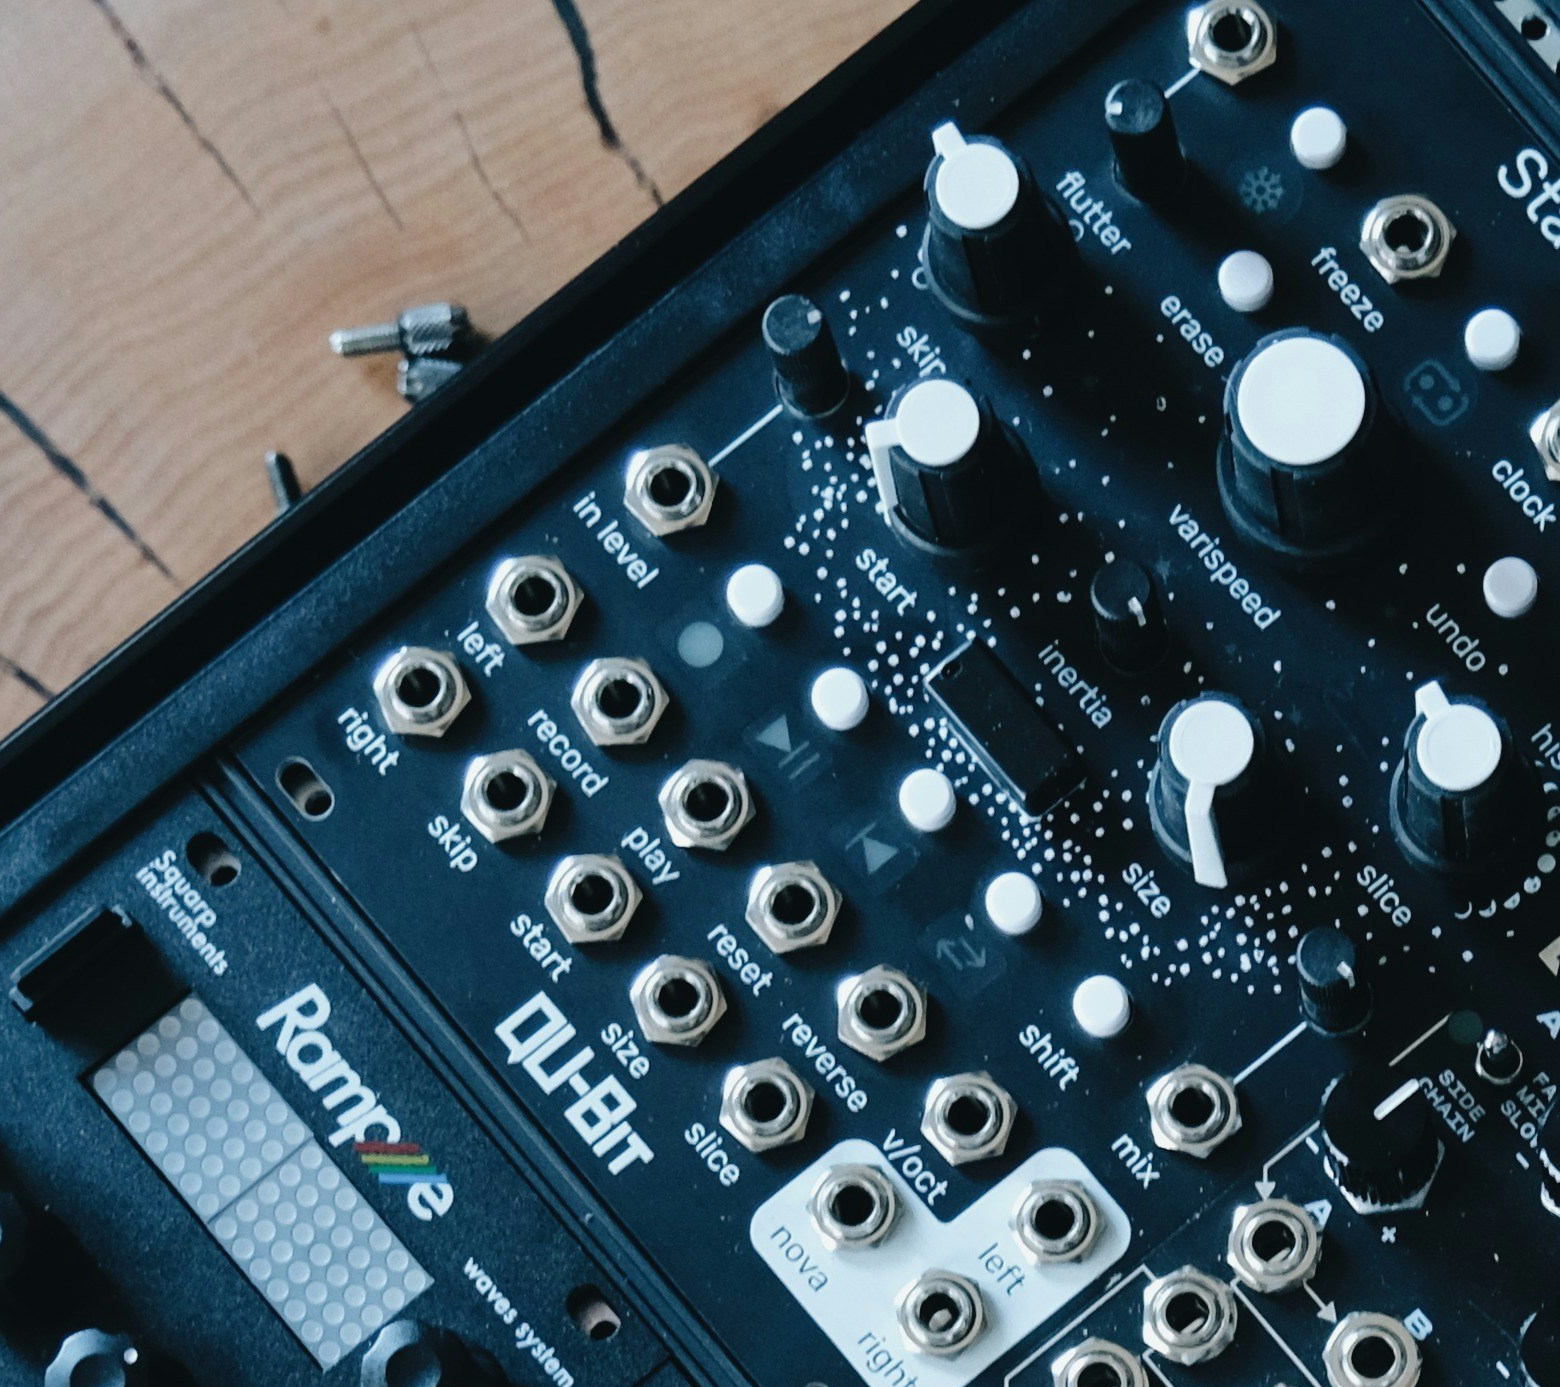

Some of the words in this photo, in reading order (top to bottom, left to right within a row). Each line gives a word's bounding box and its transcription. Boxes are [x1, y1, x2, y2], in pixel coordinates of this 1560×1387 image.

[1053, 169, 1133, 256] flutter
[1309, 245, 1385, 334] freeze
[1158, 293, 1226, 370] erase
[1489, 458, 1558, 534] clock
[570, 489, 603, 530] in
[594, 518, 661, 591] level
[1166, 502, 1283, 632] varispeed
[852, 546, 919, 618] start
[454, 619, 506, 678] left
[1424, 601, 1487, 674] undo
[1036, 638, 1113, 731] inertia
[335, 706, 401, 778] right
[525, 707, 610, 799] record
[425, 813, 479, 874] skip
[618, 825, 681, 886] play
[133, 860, 229, 977] instruments
[143, 848, 218, 939] Squarp
[1119, 861, 1172, 920] size
[1354, 863, 1413, 929] slice
[507, 912, 574, 984] start
[704, 922, 775, 999] reset
[598, 1021, 651, 1081] size
[779, 1011, 869, 1114] reverse
[1016, 1022, 1081, 1093] shift
[682, 1121, 741, 1188] slice
[880, 1127, 949, 1207] v/oct
[1109, 1132, 1162, 1191] mix
[461, 1255, 519, 1326] waves
[768, 1224, 829, 1294] nova
[976, 1241, 1026, 1298] left
